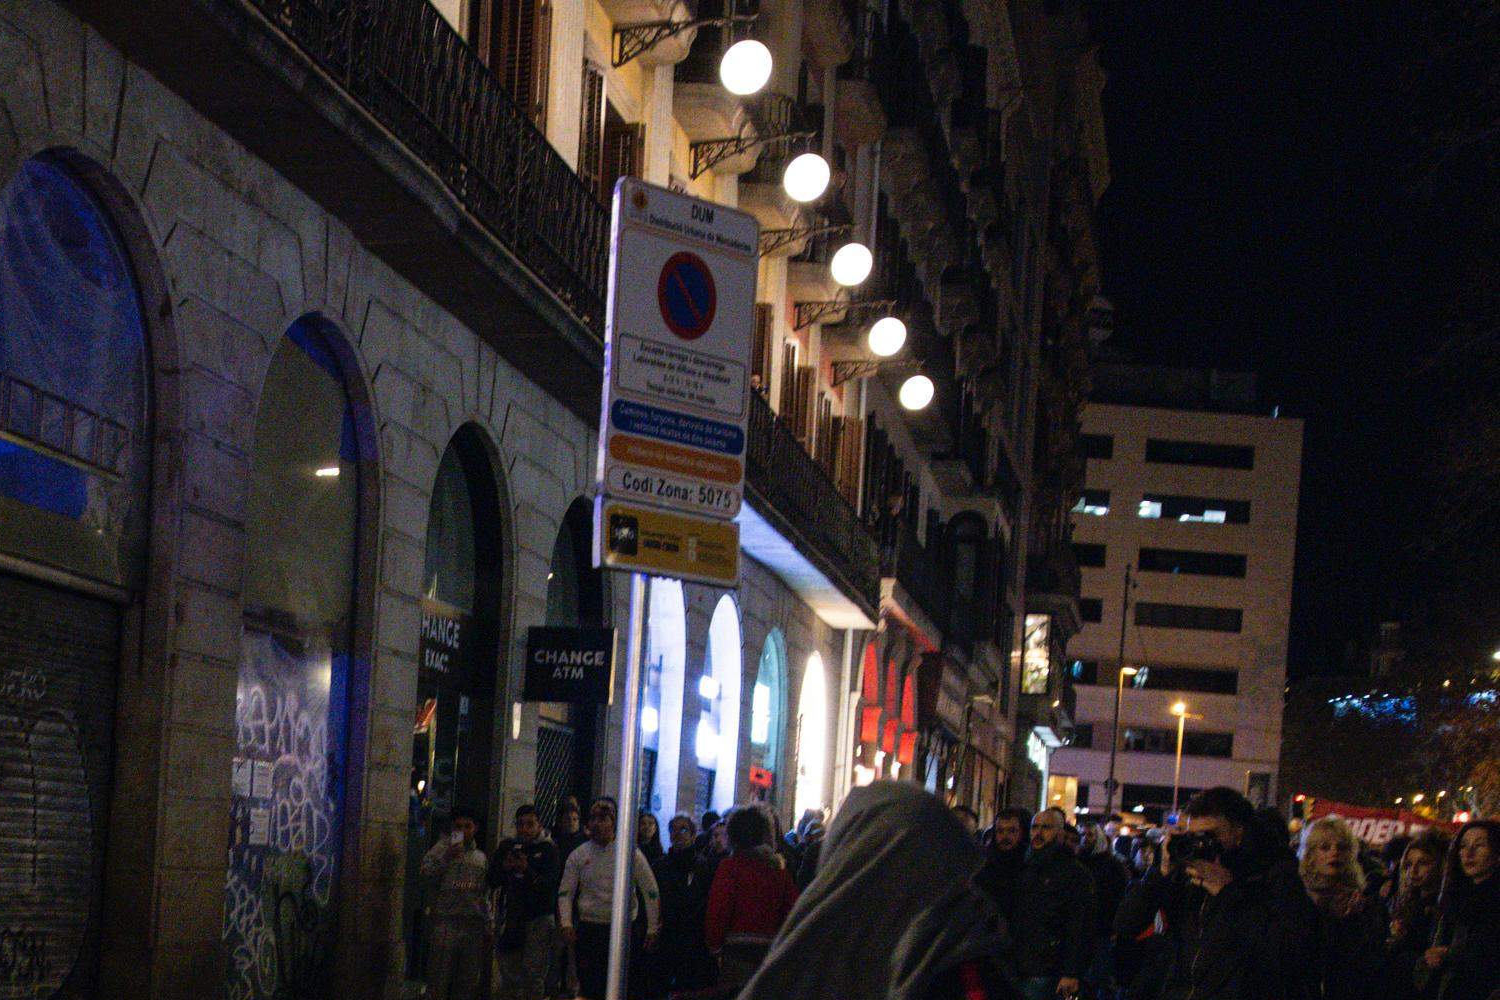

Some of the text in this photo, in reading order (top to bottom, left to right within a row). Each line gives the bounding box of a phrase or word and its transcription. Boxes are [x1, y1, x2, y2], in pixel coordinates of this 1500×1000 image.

[691, 204, 714, 224] DUM
[623, 471, 732, 508] Codi Zona: 5075
[421, 612, 461, 650] HANGE
[534, 649, 605, 667] CHANGE
[553, 666, 584, 680] ATM
